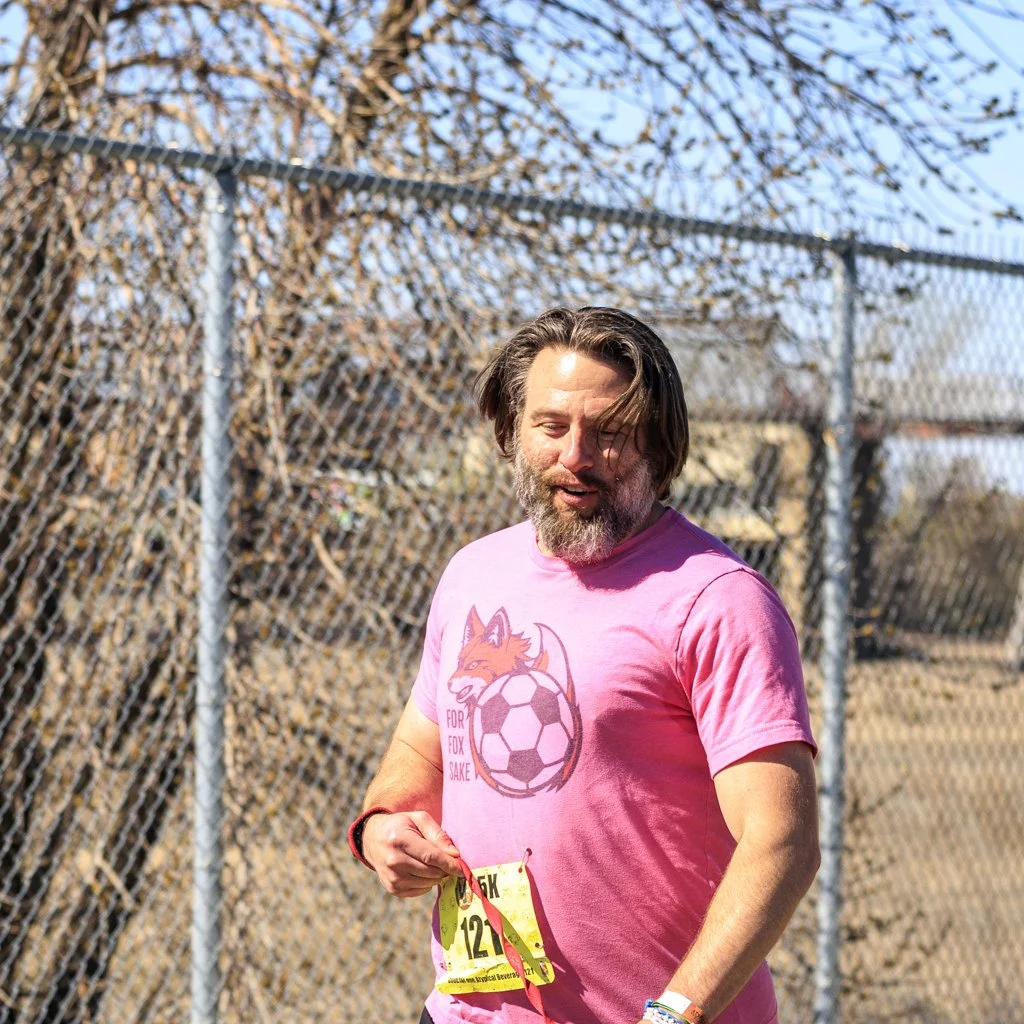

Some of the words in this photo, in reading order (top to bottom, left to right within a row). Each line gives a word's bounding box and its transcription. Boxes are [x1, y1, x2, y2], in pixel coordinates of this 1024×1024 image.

[446, 709, 465, 730] FOR
[448, 735, 465, 756] FOX
[449, 762, 471, 782] SAKE
[479, 873, 500, 899] 5K
[460, 914, 504, 961] 121
[496, 971, 521, 981] Beverag
